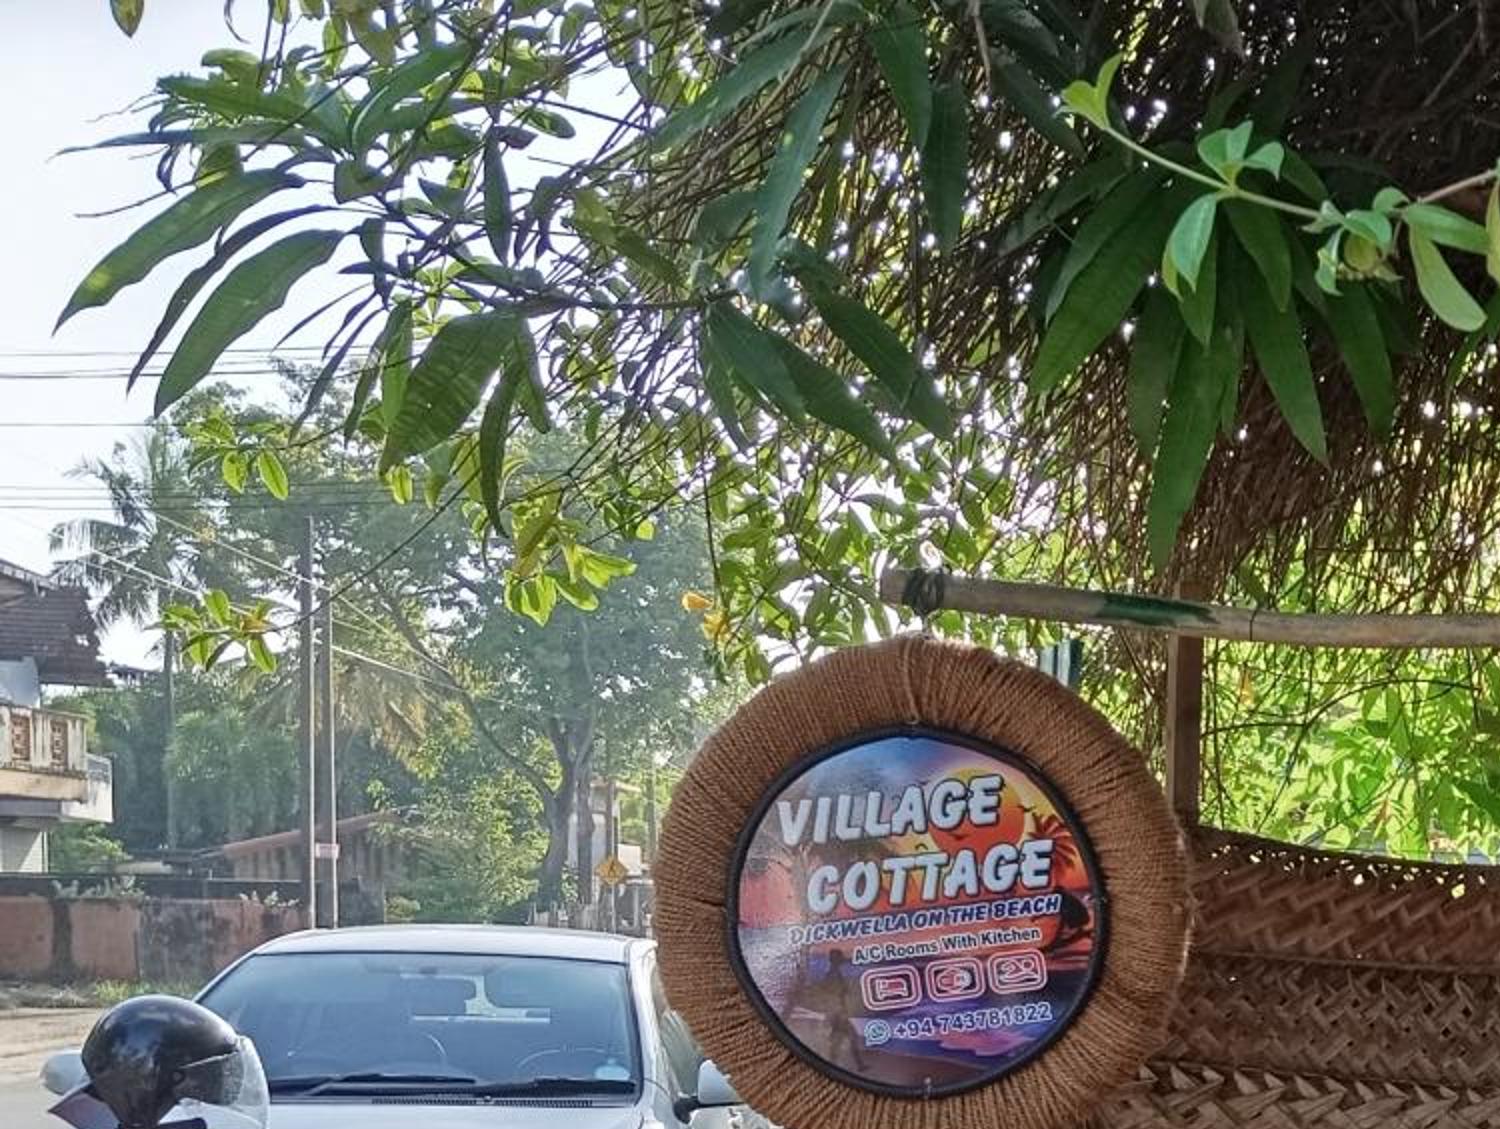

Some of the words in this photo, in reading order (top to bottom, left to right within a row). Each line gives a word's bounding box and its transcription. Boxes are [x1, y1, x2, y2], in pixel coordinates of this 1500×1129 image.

[777, 773, 1003, 846] VILLAGE
[806, 839, 1055, 913] COTTAGE
[788, 913, 911, 945] DICKWELLA
[911, 910, 944, 930] ON
[945, 904, 989, 924] THE
[991, 894, 1061, 919] BEACH
[886, 941, 938, 959] Rooms
[942, 933, 978, 951] With
[981, 927, 1041, 945] Kitchen
[895, 1018, 934, 1037] +94
[940, 1003, 1052, 1033] 743781822
